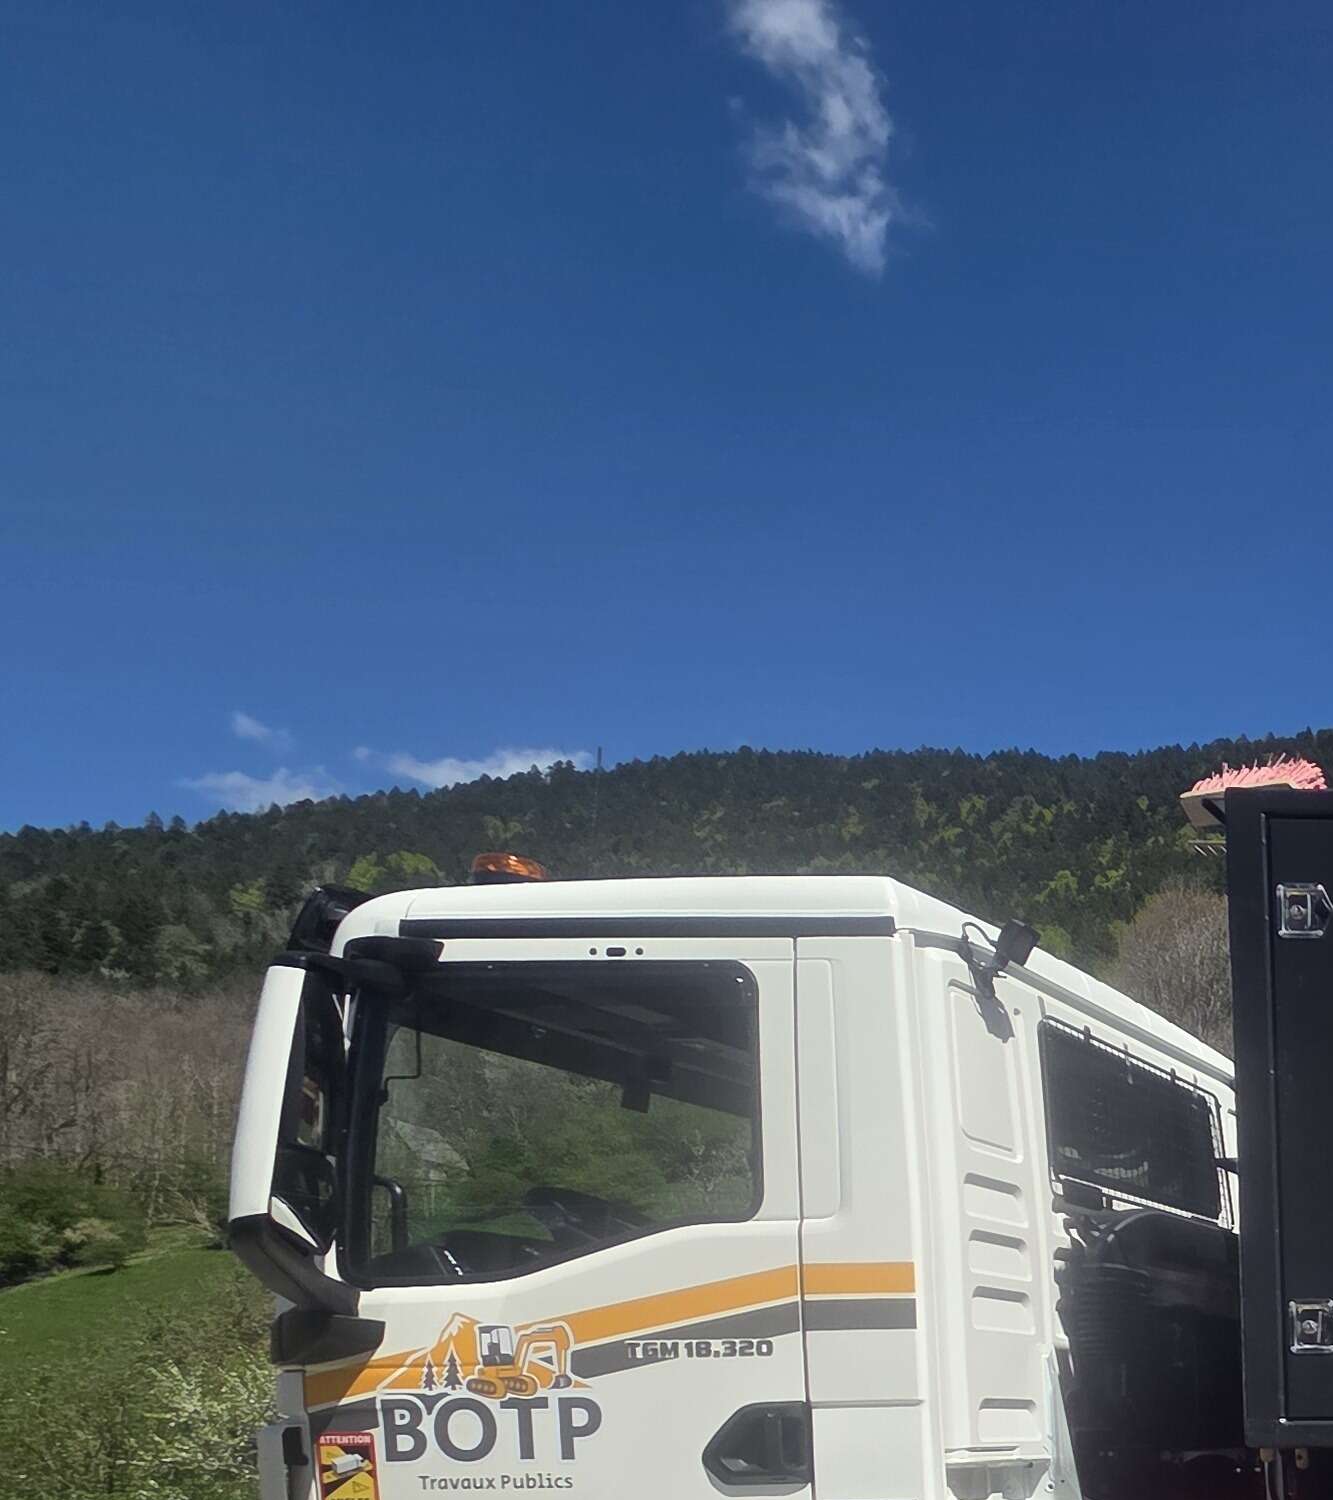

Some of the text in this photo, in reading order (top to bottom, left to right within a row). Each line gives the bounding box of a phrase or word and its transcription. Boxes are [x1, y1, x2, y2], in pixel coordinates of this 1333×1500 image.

[626, 1340, 774, 1359] TGM 18.320
[381, 1396, 602, 1463] BOTP
[319, 1435, 371, 1444] ATTENTION
[419, 1473, 574, 1490] Travaux Publics
